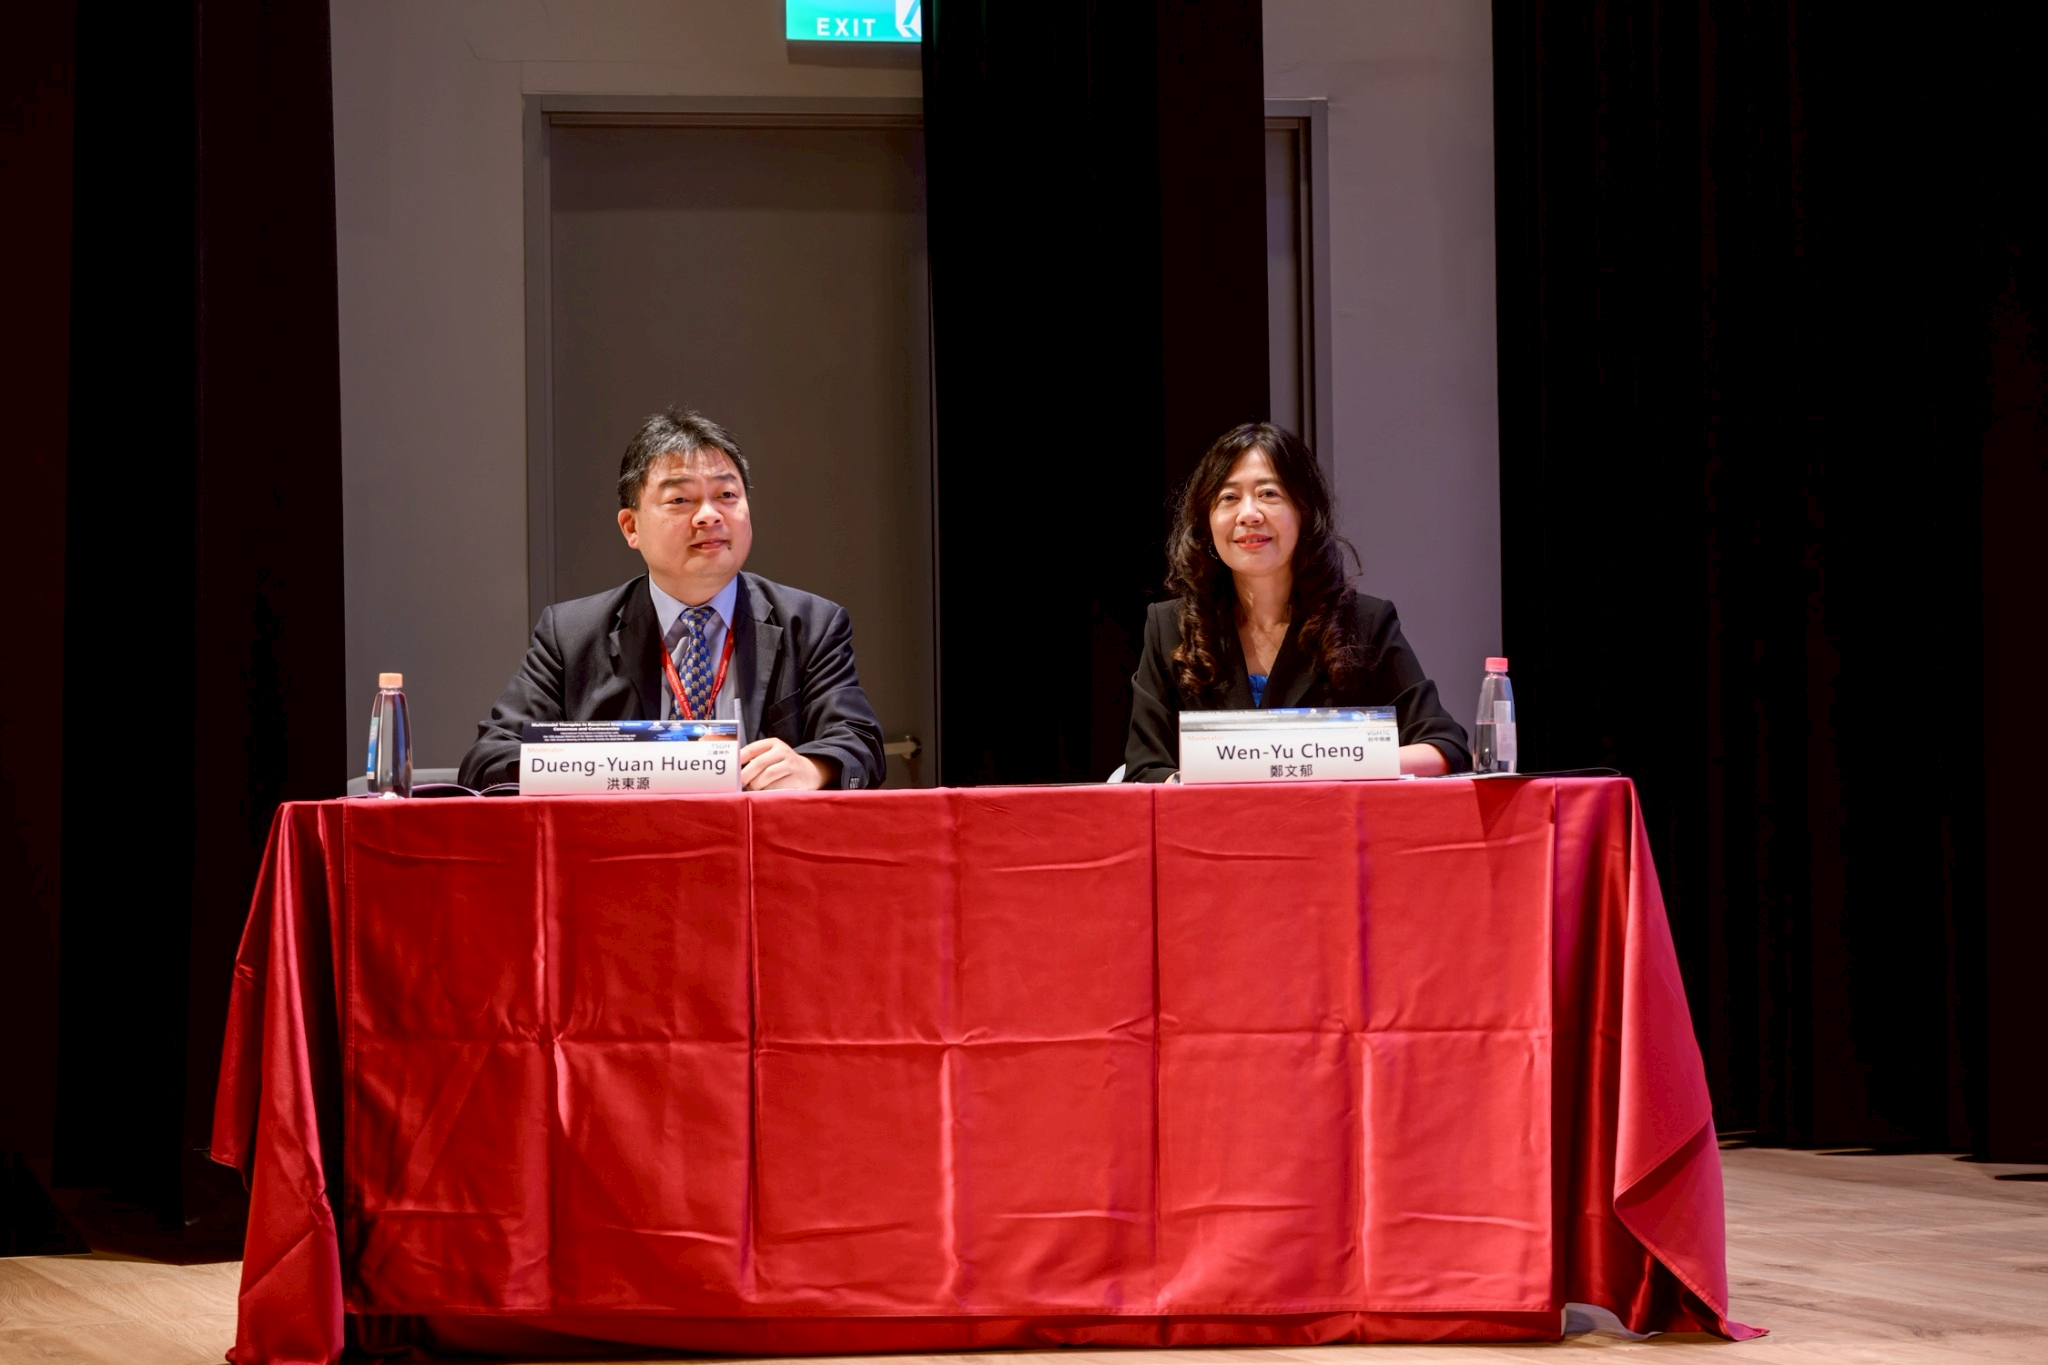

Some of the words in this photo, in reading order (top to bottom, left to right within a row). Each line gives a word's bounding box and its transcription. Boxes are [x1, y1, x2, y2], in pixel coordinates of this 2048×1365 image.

[817, 17, 876, 37] EXIT
[1216, 744, 1294, 760] Wen-Yu
[1301, 743, 1364, 762] Cheng
[531, 756, 654, 776] Dueng-Yuan
[661, 756, 726, 776] Hueng
[1270, 764, 1313, 778] 鄭文郁
[607, 777, 650, 791] 洪東源
